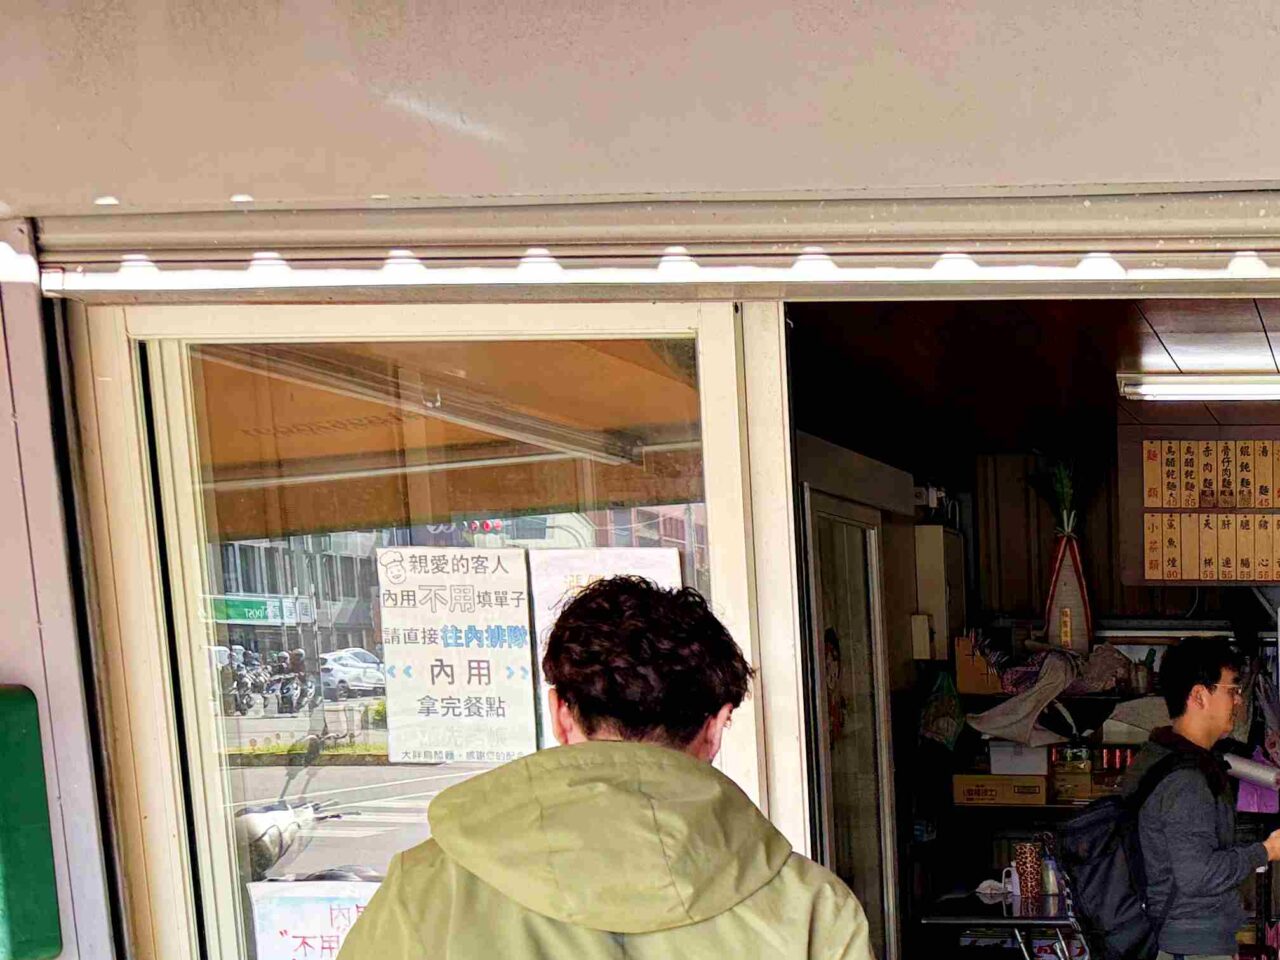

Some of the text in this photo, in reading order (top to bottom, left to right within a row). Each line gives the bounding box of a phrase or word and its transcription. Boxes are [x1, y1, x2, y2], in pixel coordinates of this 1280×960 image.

[409, 555, 509, 574] 親愛的客人
[417, 695, 506, 718] 拿完餐點
